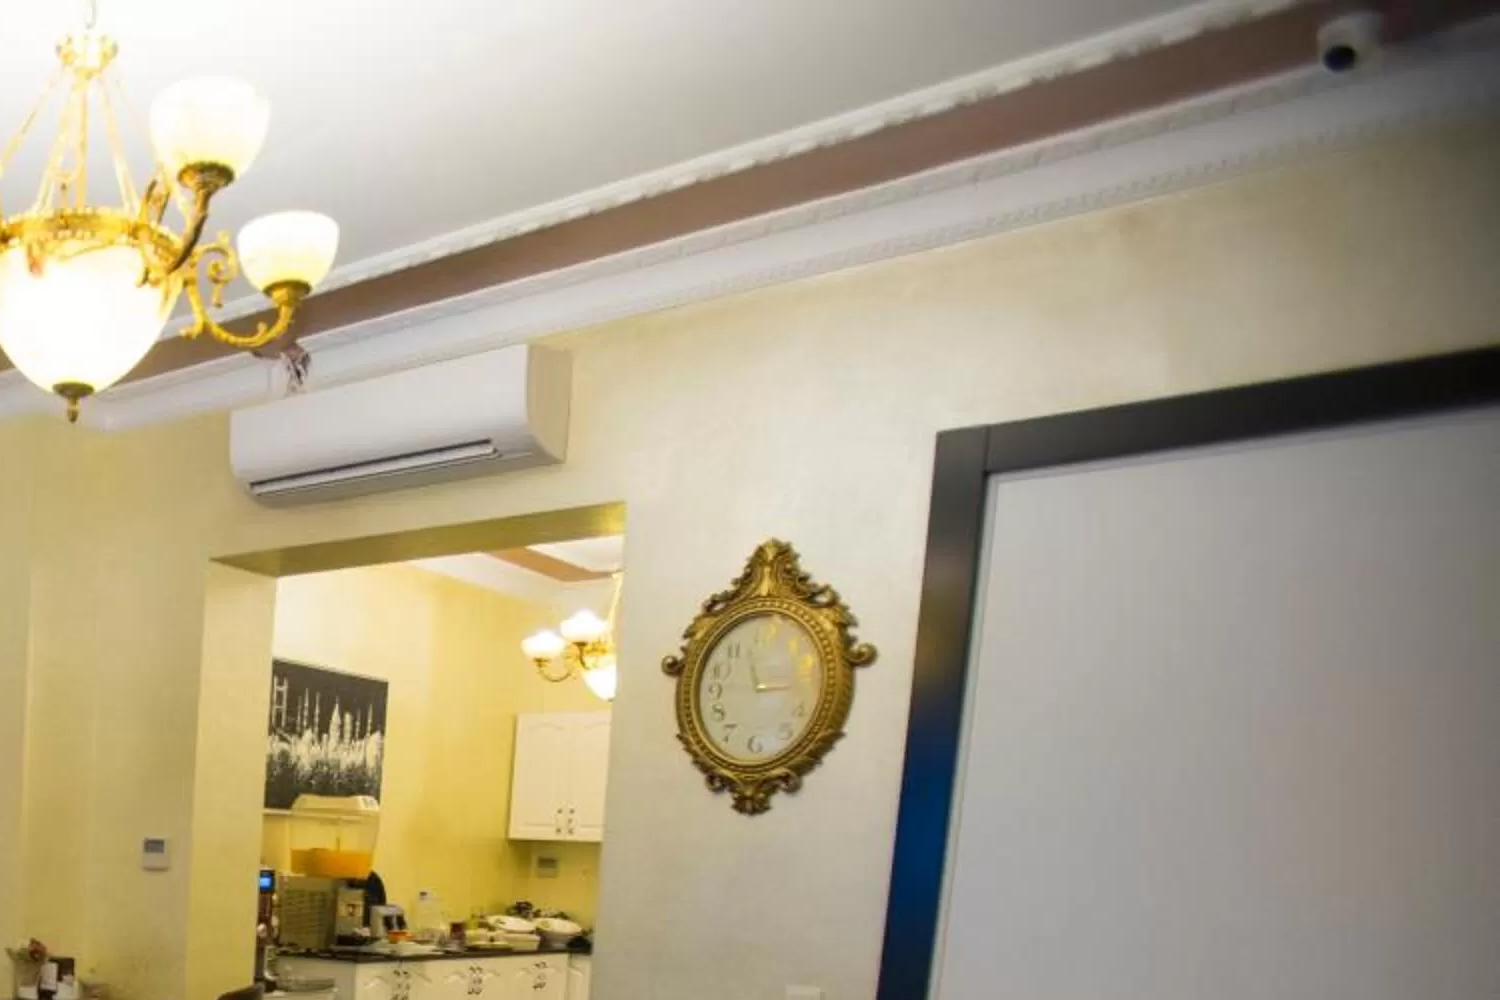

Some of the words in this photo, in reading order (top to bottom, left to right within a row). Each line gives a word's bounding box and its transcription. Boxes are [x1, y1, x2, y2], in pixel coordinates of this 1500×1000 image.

[708, 683, 723, 700] 9
[710, 703, 725, 721] 8
[722, 723, 738, 743] 7
[778, 722, 793, 740] 5
[747, 735, 763, 753] 6
